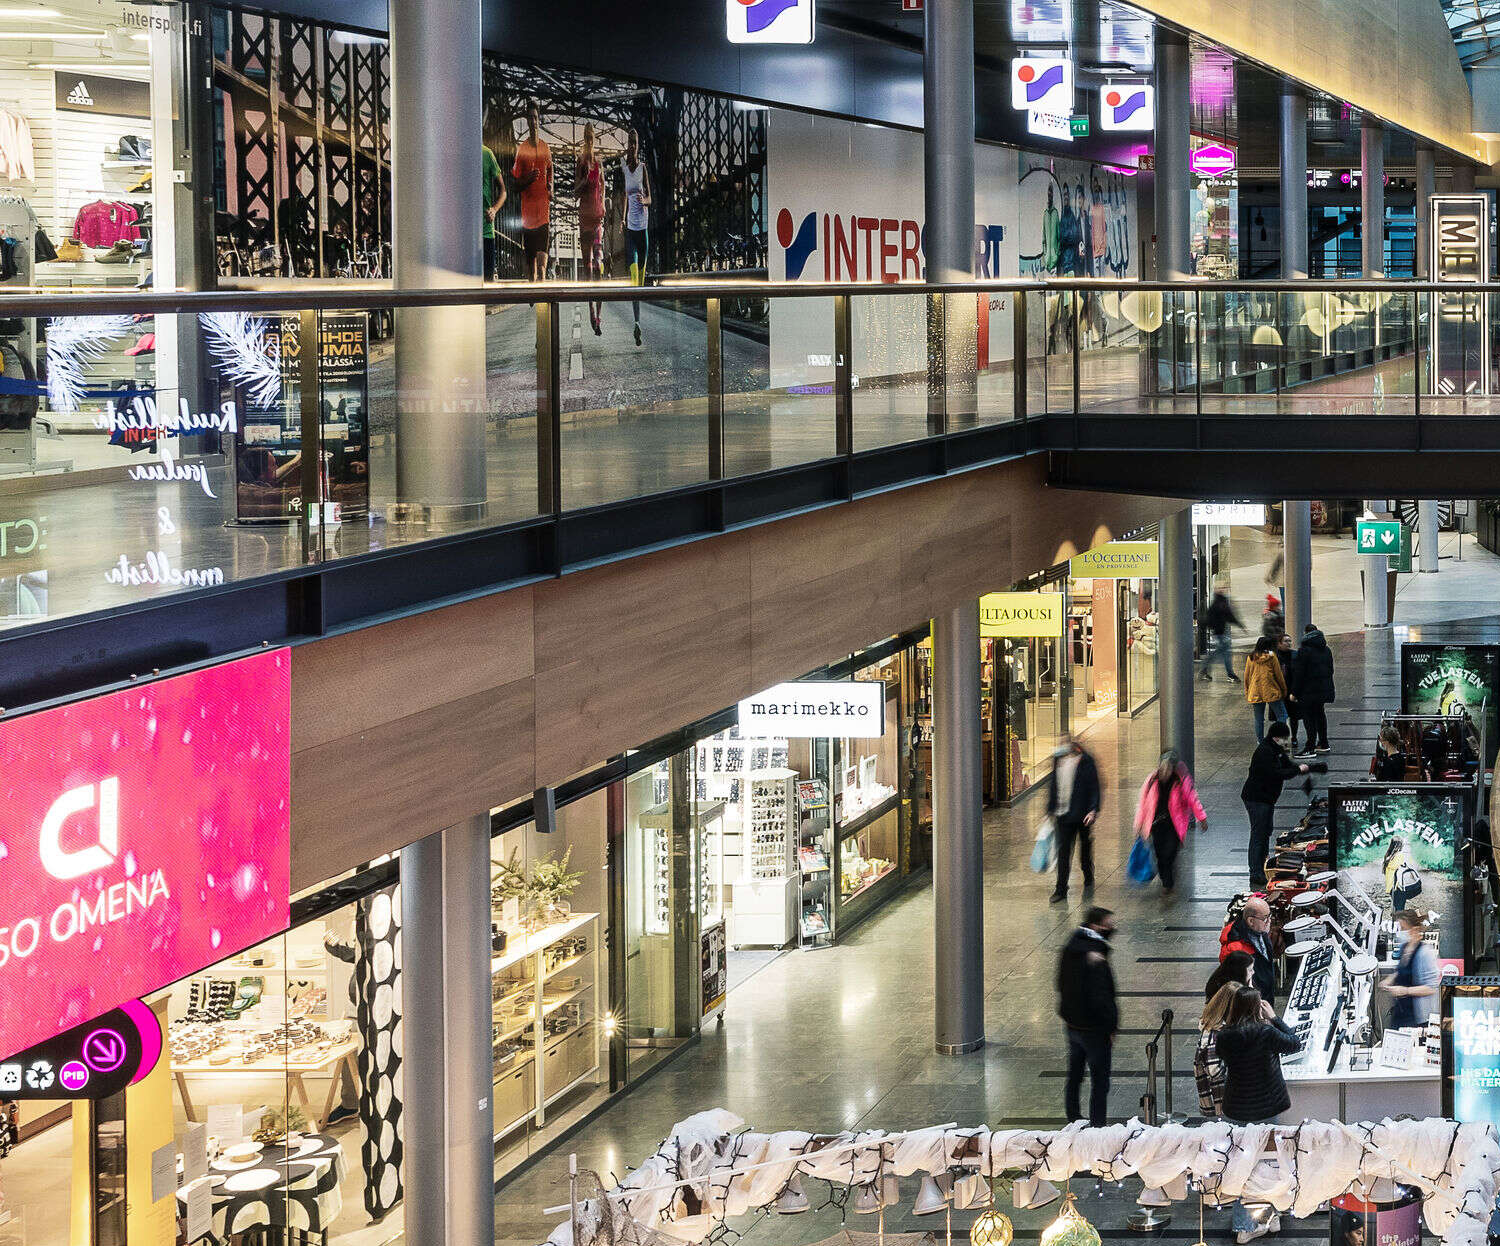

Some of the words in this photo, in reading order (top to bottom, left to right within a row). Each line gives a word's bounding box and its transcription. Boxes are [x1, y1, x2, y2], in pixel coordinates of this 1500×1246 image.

[824, 213, 1004, 284] INTERRT
[1084, 552, 1151, 564] L'OCCITANE
[1418, 670, 1441, 689] TUE
[1440, 666, 1485, 690] LASTEN
[751, 701, 869, 716] marimekko
[1352, 823, 1384, 849] TUE
[1383, 819, 1445, 849] LASTEN
[50, 868, 171, 943] OMENA
[63, 1071, 85, 1081] P1B
